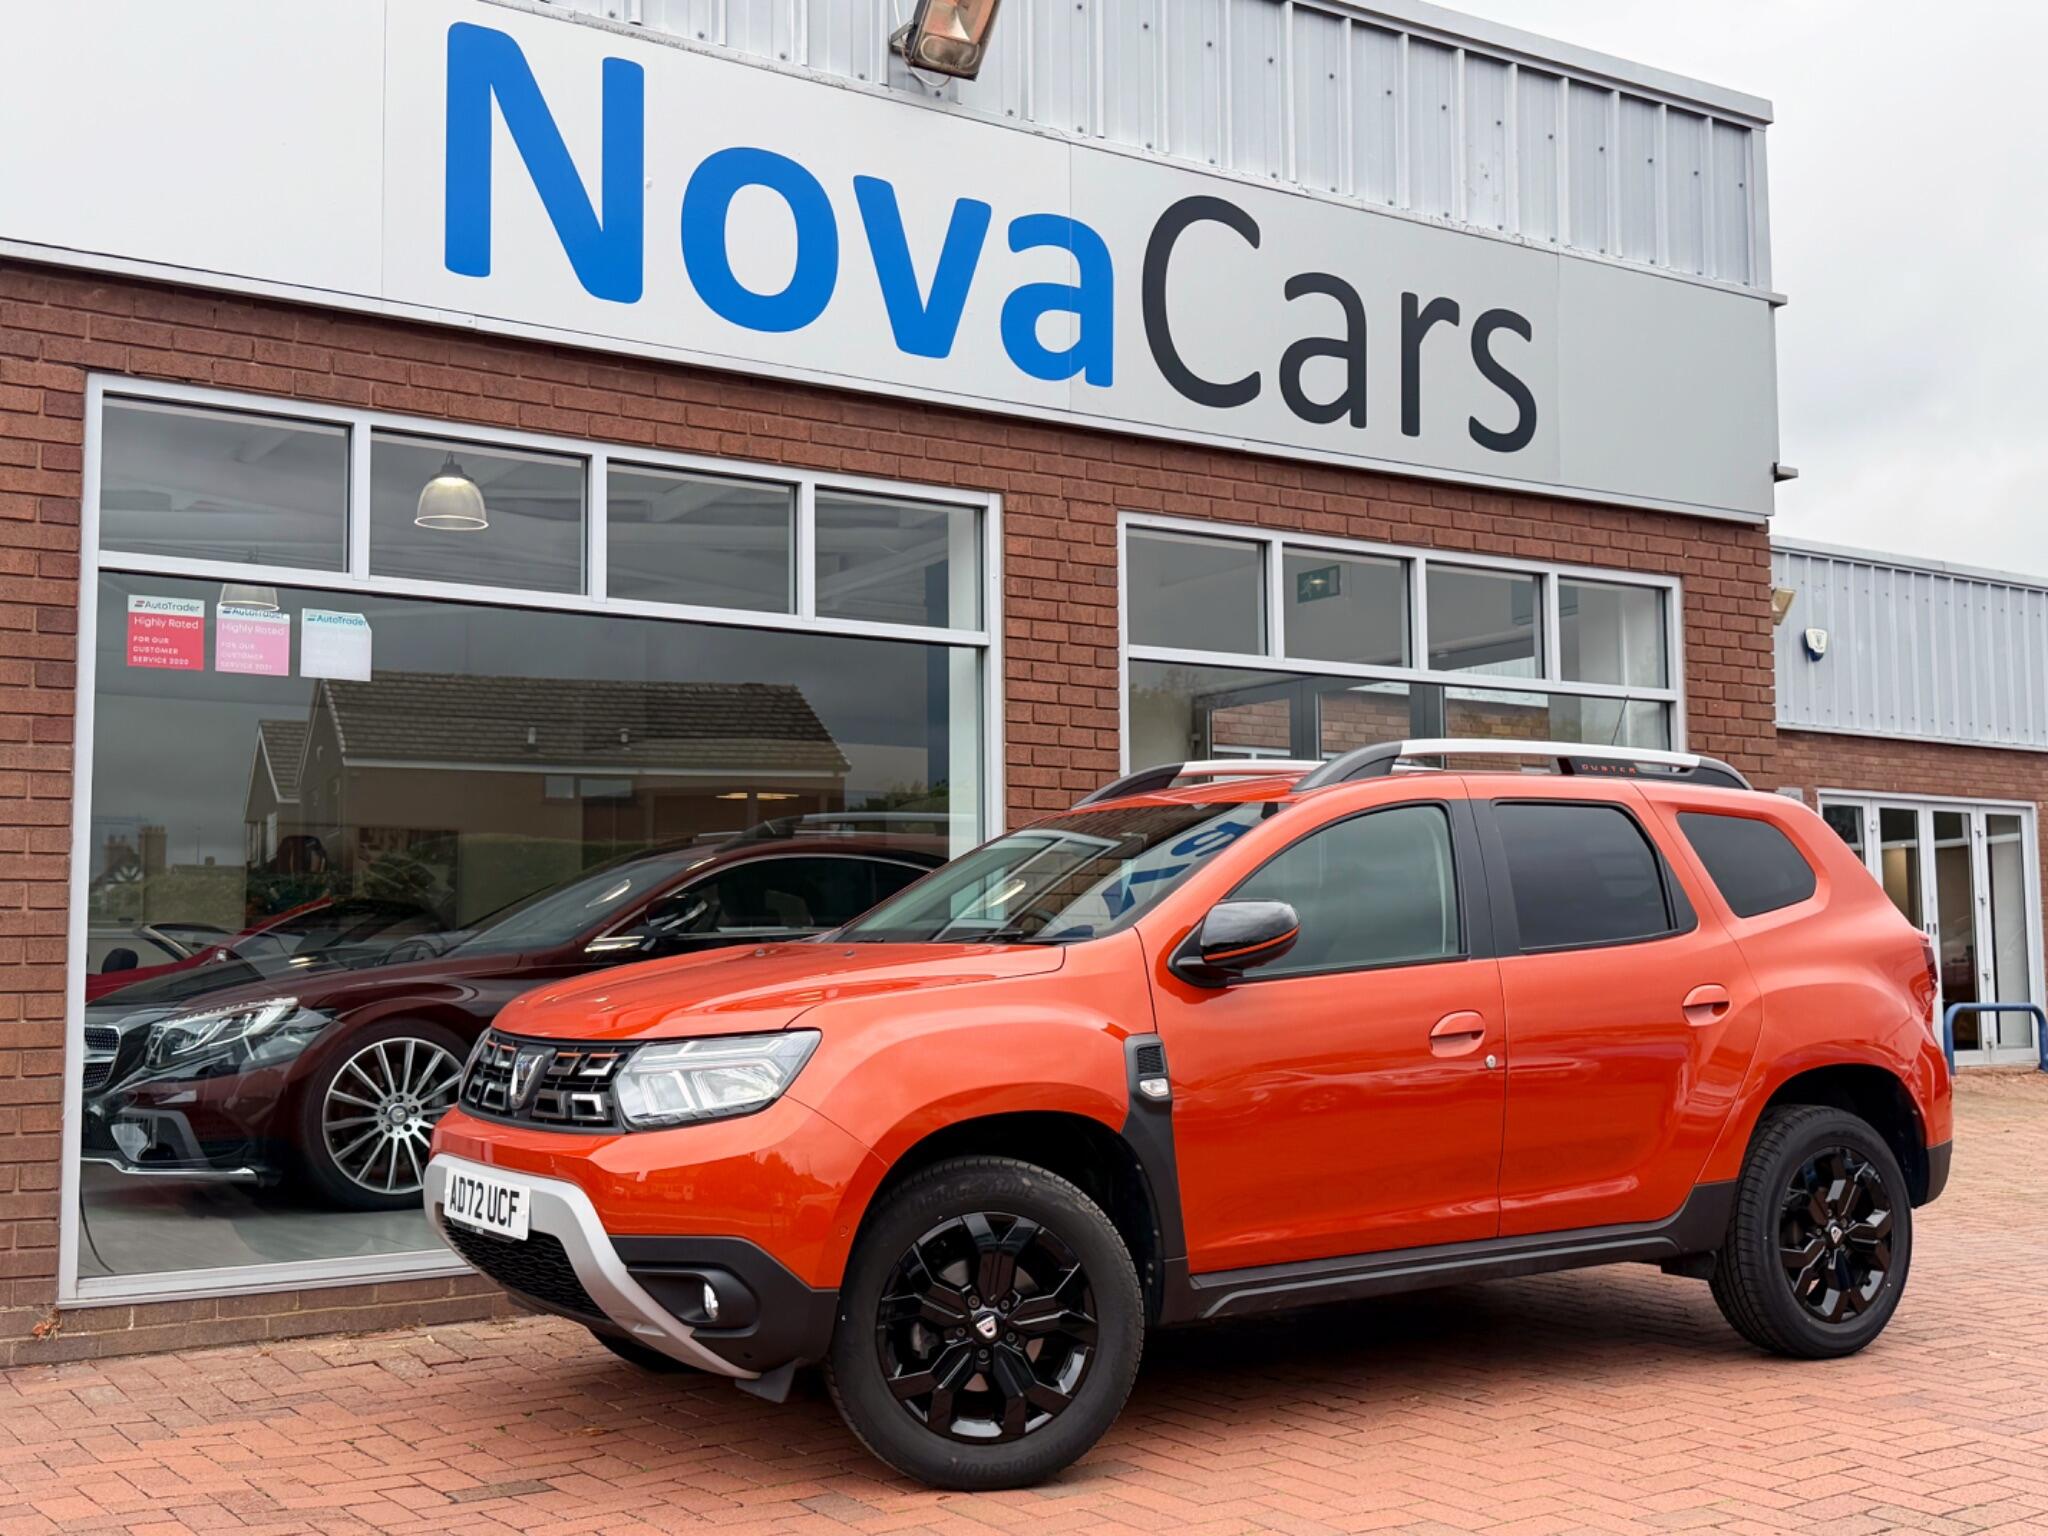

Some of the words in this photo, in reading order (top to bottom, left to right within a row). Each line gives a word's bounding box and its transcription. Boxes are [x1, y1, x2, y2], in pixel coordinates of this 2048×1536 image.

[145, 600, 200, 612] AutoTrader
[134, 616, 167, 629] Highly
[168, 618, 199, 630] Rated
[221, 621, 254, 634] Highly
[255, 624, 285, 636] Rated
[133, 635, 150, 644] FOR
[151, 636, 169, 645] OUR
[132, 645, 179, 655] CUSTOMER
[132, 655, 167, 665] SERVICE
[449, 1174, 484, 1220] AD72
[487, 1184, 520, 1229] UCF
